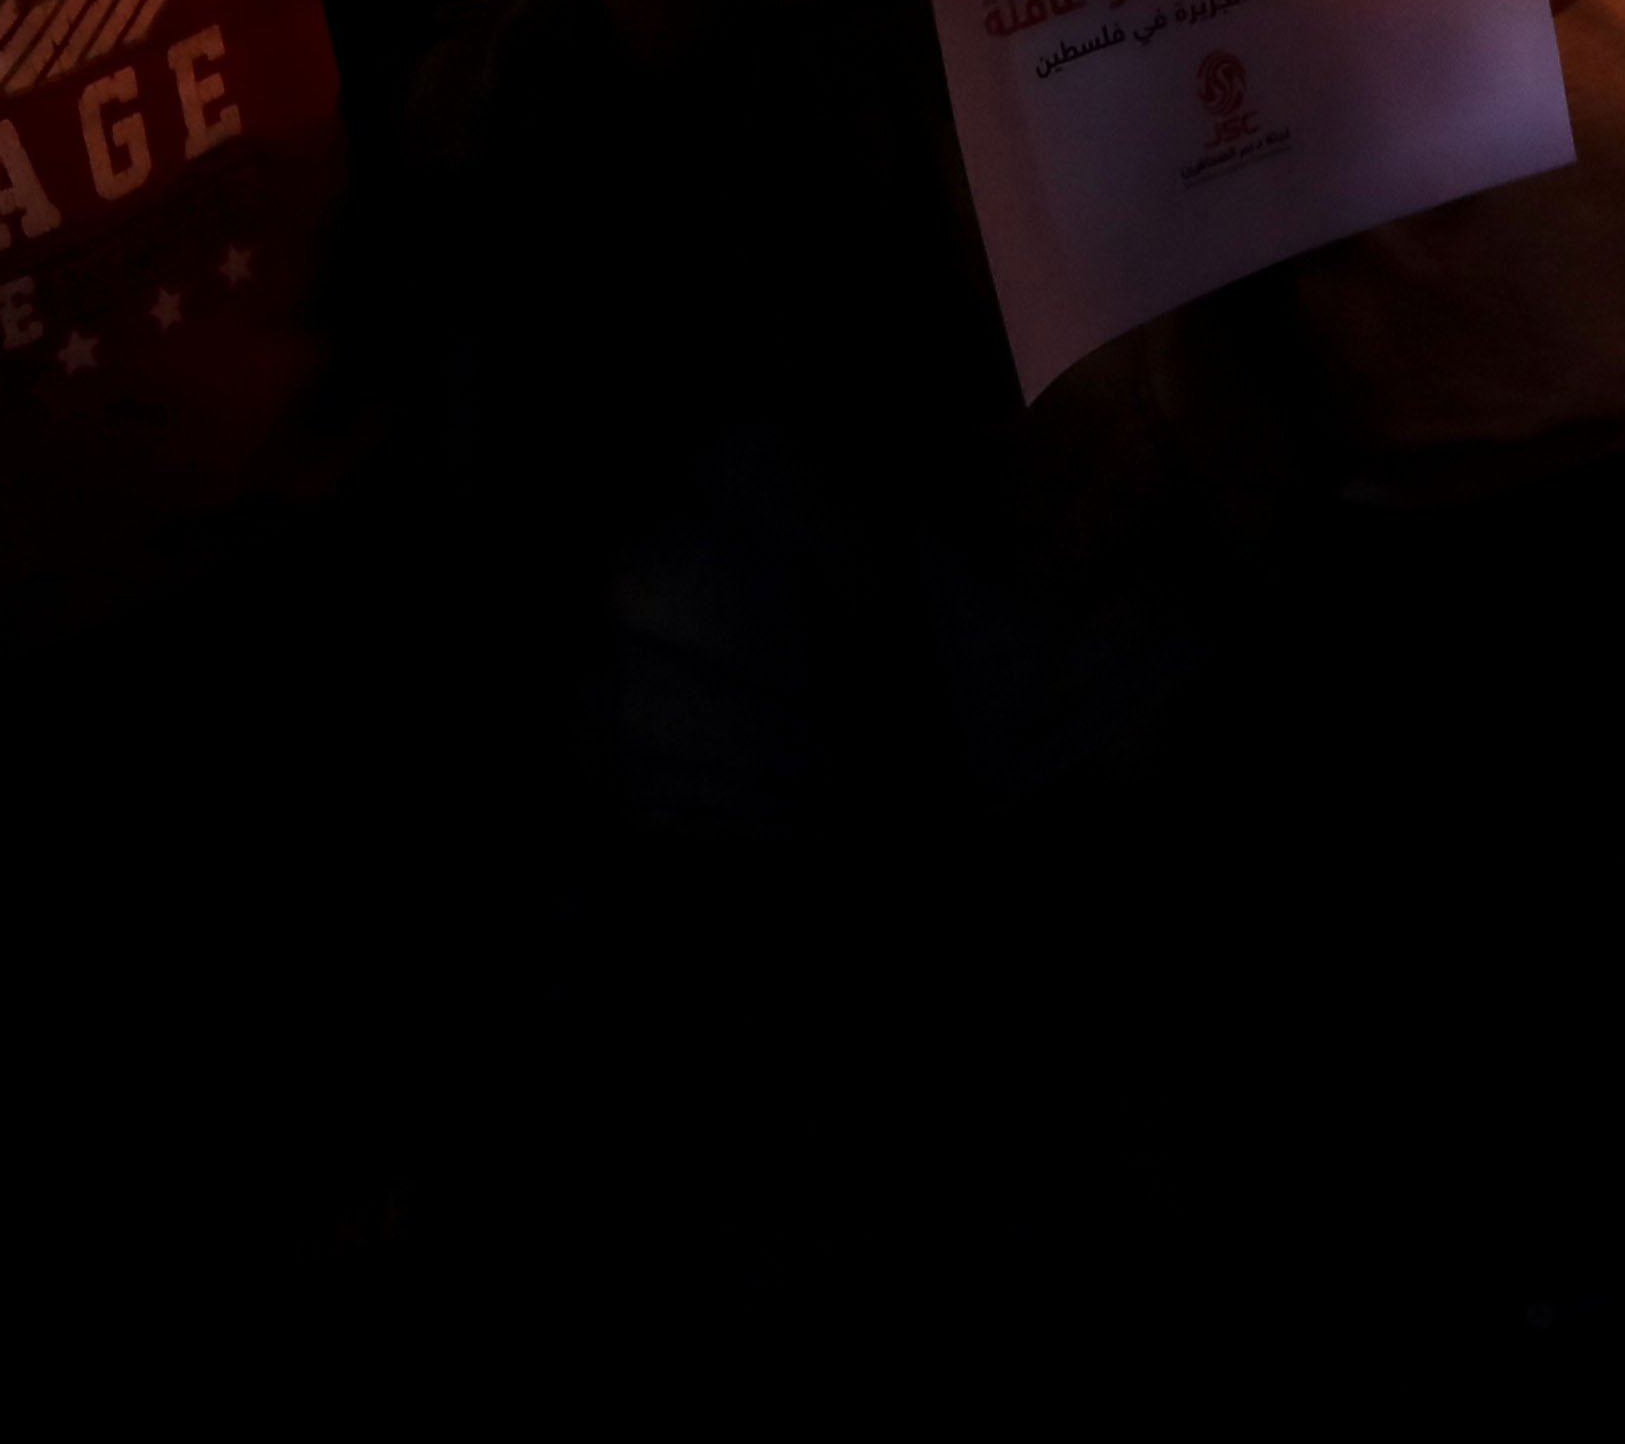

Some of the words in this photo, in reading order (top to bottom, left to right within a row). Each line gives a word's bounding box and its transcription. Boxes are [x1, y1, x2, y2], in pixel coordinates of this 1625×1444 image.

[1135, 13, 1166, 42] في
[1037, 27, 1124, 77] فلسطين
[1203, 110, 1260, 148] JSC
